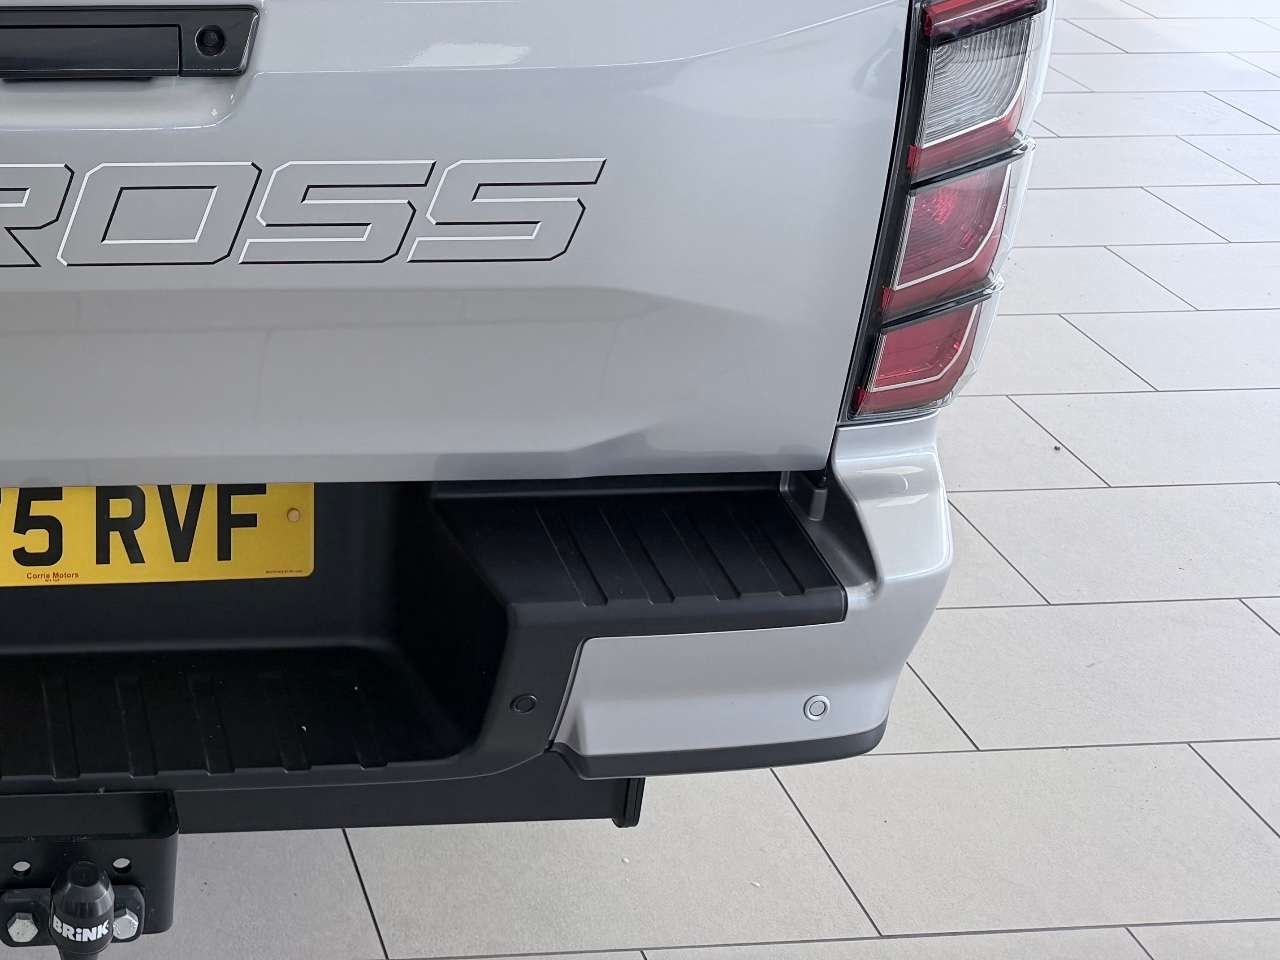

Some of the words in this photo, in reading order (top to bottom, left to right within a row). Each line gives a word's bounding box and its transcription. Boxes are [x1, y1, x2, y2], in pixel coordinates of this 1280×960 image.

[95, 483, 267, 565] RVF
[26, 571, 51, 580] Corrie
[52, 571, 80, 579] Motors
